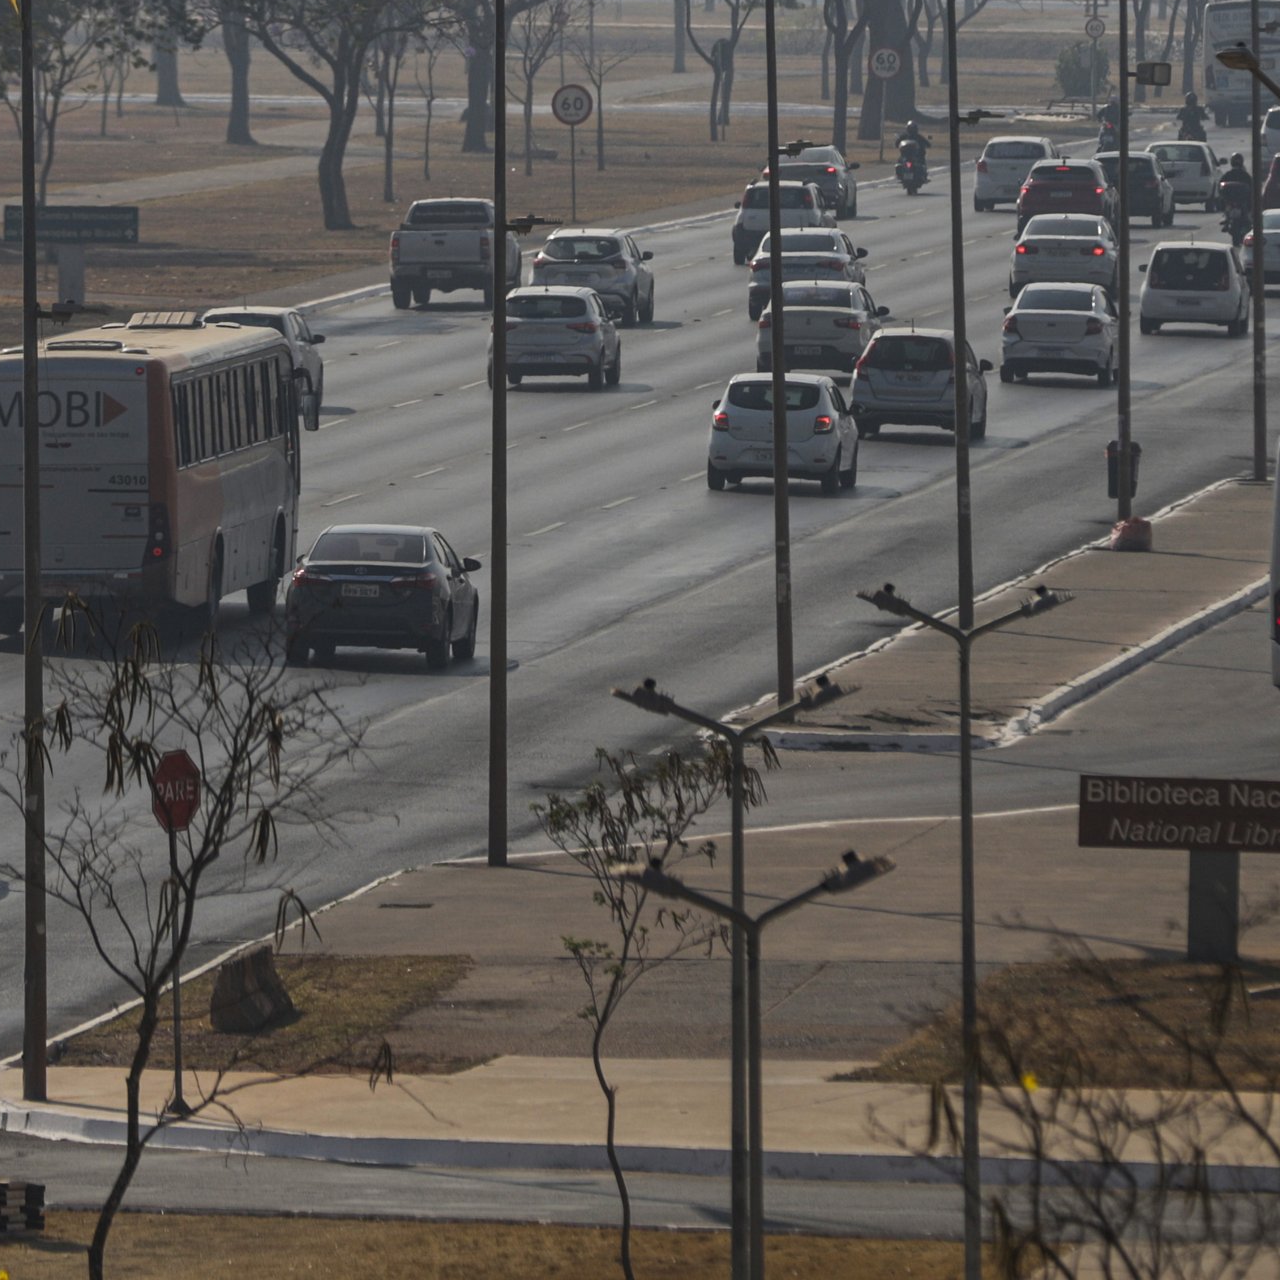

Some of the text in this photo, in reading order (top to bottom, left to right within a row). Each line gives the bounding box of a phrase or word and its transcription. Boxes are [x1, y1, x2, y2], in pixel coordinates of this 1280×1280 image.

[876, 53, 896, 65] 60
[562, 97, 584, 111] 60
[108, 475, 147, 486] 43010
[156, 778, 195, 803] PARE
[1087, 779, 1221, 807] Biblioteca
[1109, 818, 1222, 845] National
